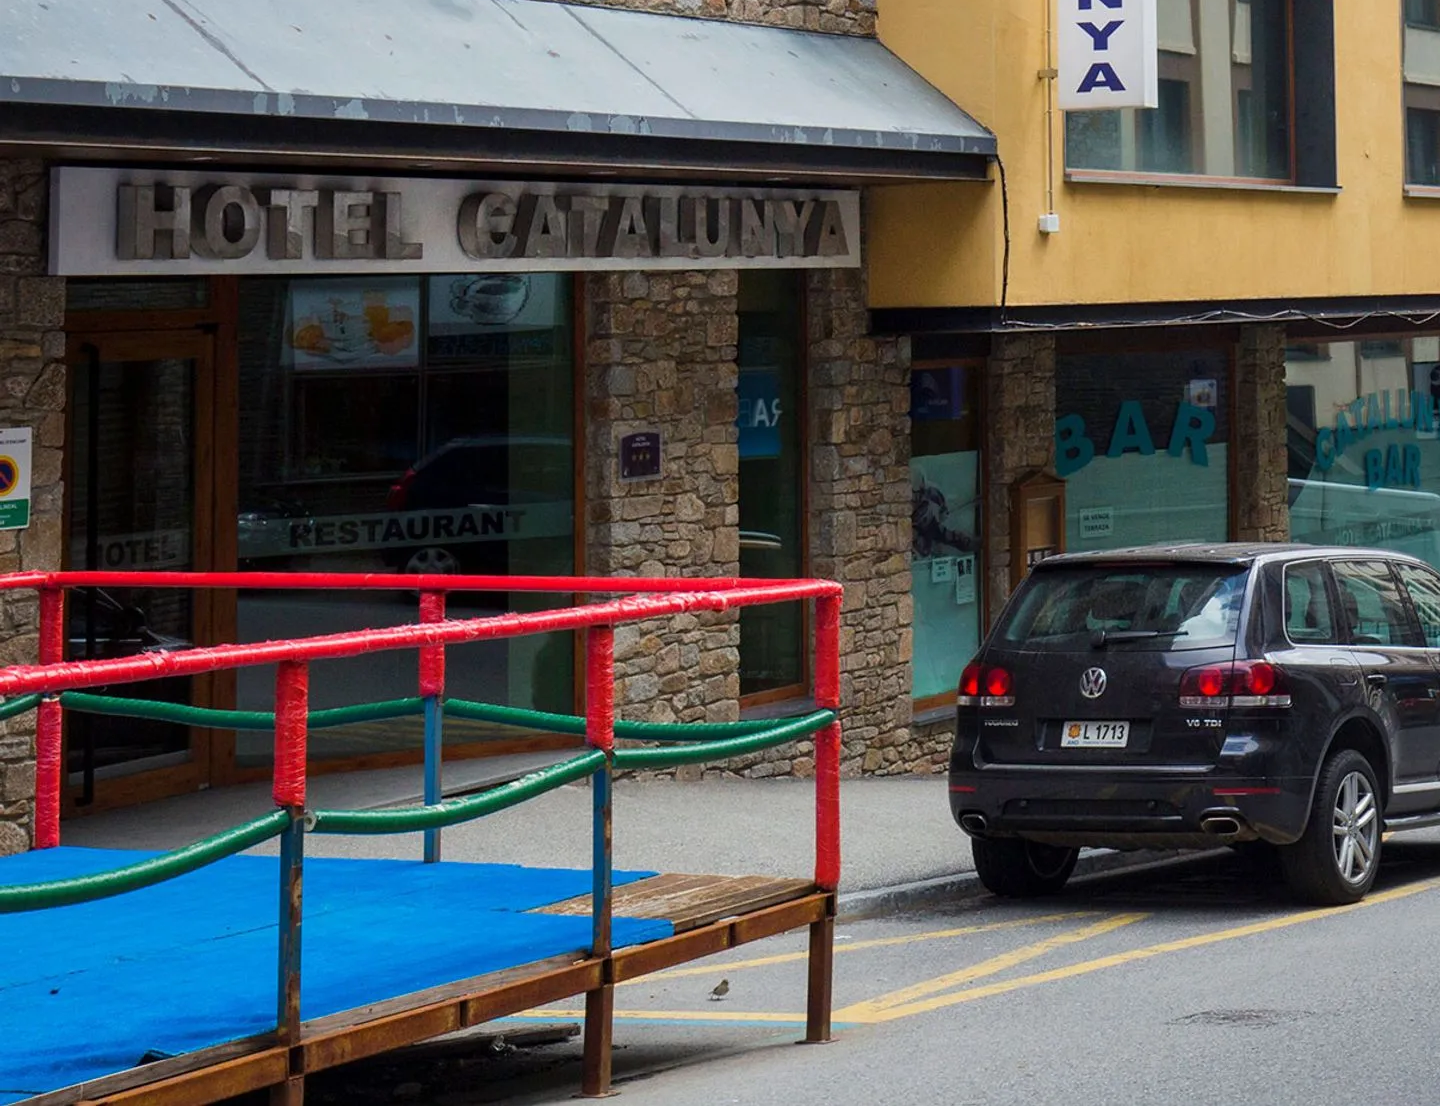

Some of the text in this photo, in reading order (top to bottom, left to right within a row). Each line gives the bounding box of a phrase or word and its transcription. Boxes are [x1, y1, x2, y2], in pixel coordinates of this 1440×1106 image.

[117, 184, 851, 262] HOTEL CATALUNYA
[1055, 398, 1216, 477] BAR
[1366, 442, 1422, 491] BAR
[289, 510, 528, 548] RESTAURANT
[1083, 724, 1125, 740] L 1713
